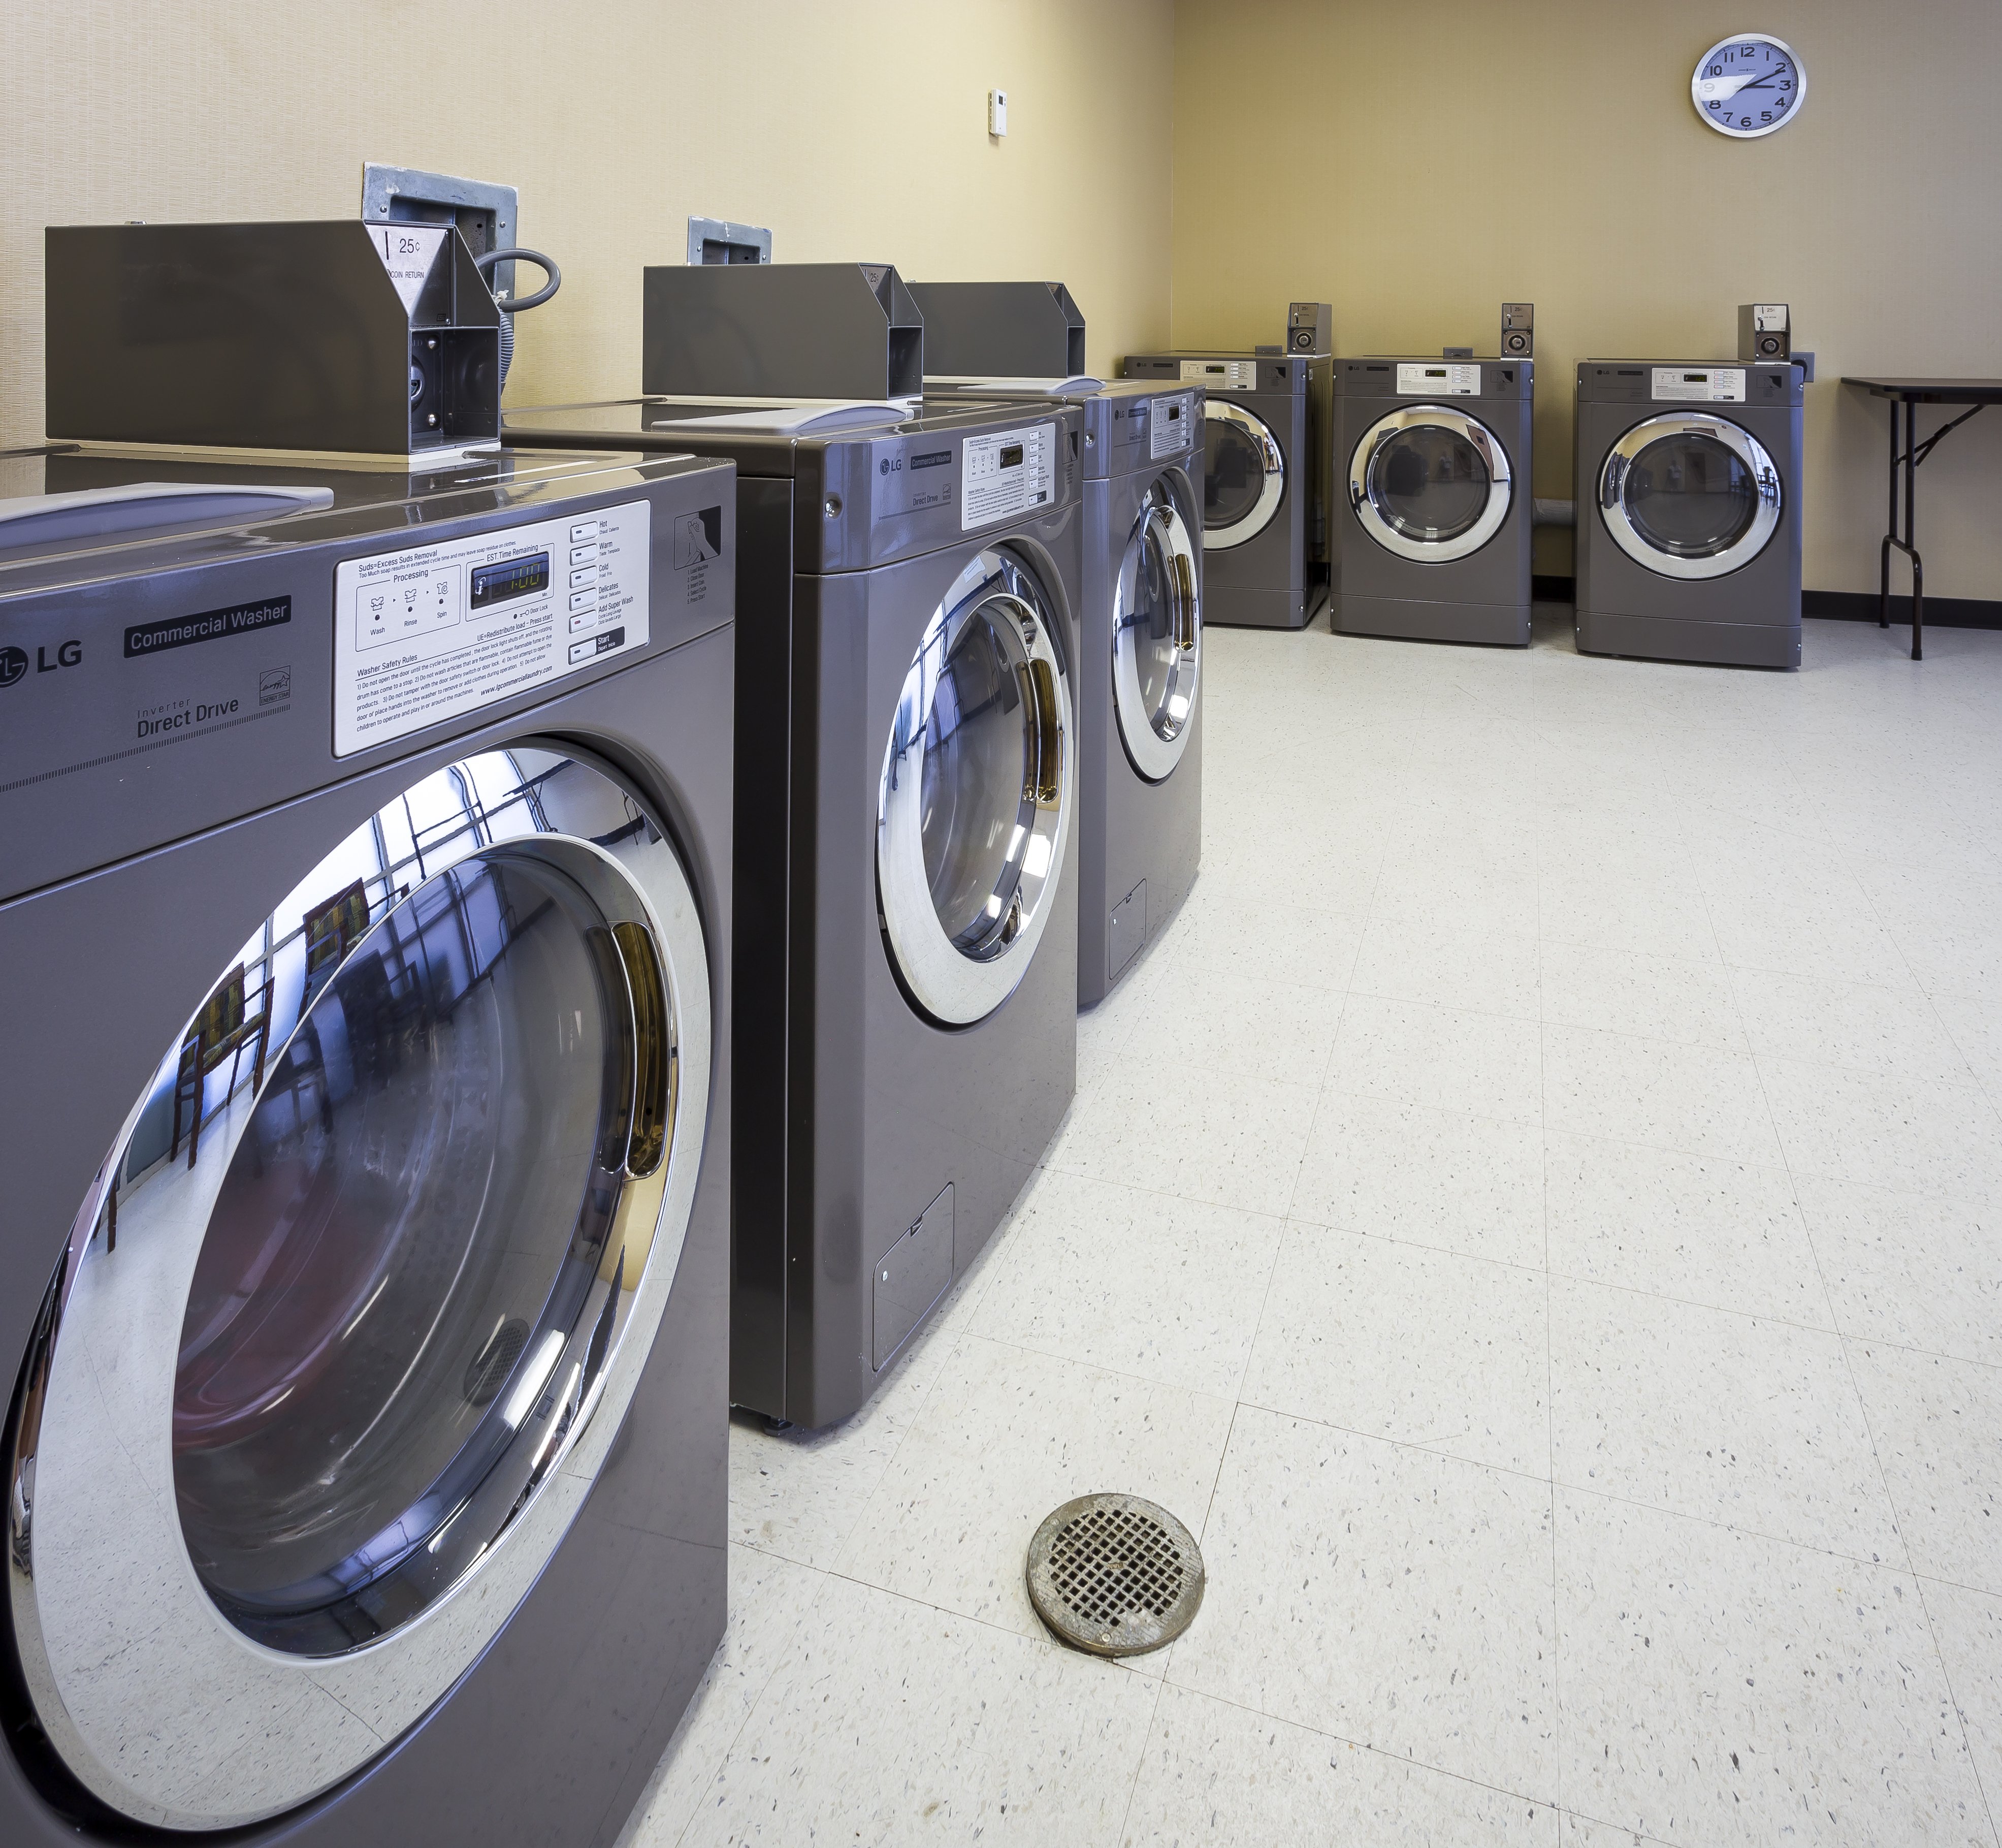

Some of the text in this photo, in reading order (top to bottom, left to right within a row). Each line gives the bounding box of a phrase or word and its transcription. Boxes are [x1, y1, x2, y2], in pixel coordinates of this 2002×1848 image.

[1724, 52, 1734, 62] 11
[1740, 47, 1755, 57] 12
[1766, 51, 1769, 61] 1
[1710, 65, 1722, 76] 10
[1774, 62, 1786, 73] 2
[1703, 83, 1715, 92] 9
[1779, 80, 1791, 91] 3
[1709, 100, 1722, 109] 8
[1774, 97, 1786, 107] 4
[1723, 112, 1733, 122] 7
[1760, 111, 1772, 121] 5
[1740, 117, 1752, 127] 6
[400, 239, 420, 253] 25¢
[891, 459, 901, 471] LG
[912, 455, 951, 467] Commercial Washer
[913, 495, 938, 506] Direct Drive
[599, 541, 612, 550] Warm
[487, 545, 538, 562] EST.Time Remaining
[359, 550, 437, 572] Suds=Excess Suds Removal
[599, 563, 608, 571] Cold
[394, 569, 428, 583] Processing
[599, 583, 619, 594] Delicates
[598, 596, 633, 613] Add Super Wash
[131, 603, 287, 650] Commercial Washer
[370, 627, 385, 635] Wash
[477, 626, 515, 641] UE=Redistribute
[516, 621, 525, 629] load
[530, 617, 542, 625] Press
[598, 635, 609, 645] Start
[37, 640, 82, 673] LG
[450, 650, 471, 661] completed
[358, 655, 417, 677] Washer Safety Rules
[447, 664, 462, 672] articles
[479, 652, 499, 662] flammable,
[404, 687, 419, 696] tamper
[463, 668, 476, 677] switch
[481, 666, 552, 695] www.lgcommerciallaundry.com
[261, 695, 278, 704] ENERGY
[375, 708, 388, 717] place
[389, 703, 402, 711] hands
[421, 691, 437, 700] washer
[443, 684, 458, 692] remove
[472, 675, 486, 683] clothes
[138, 697, 191, 719] Inverter
[138, 699, 239, 738] Direct Drive
[357, 722, 376, 732] children
[383, 713, 401, 723] operate
[410, 707, 420, 715] play
[431, 697, 446, 707] around
